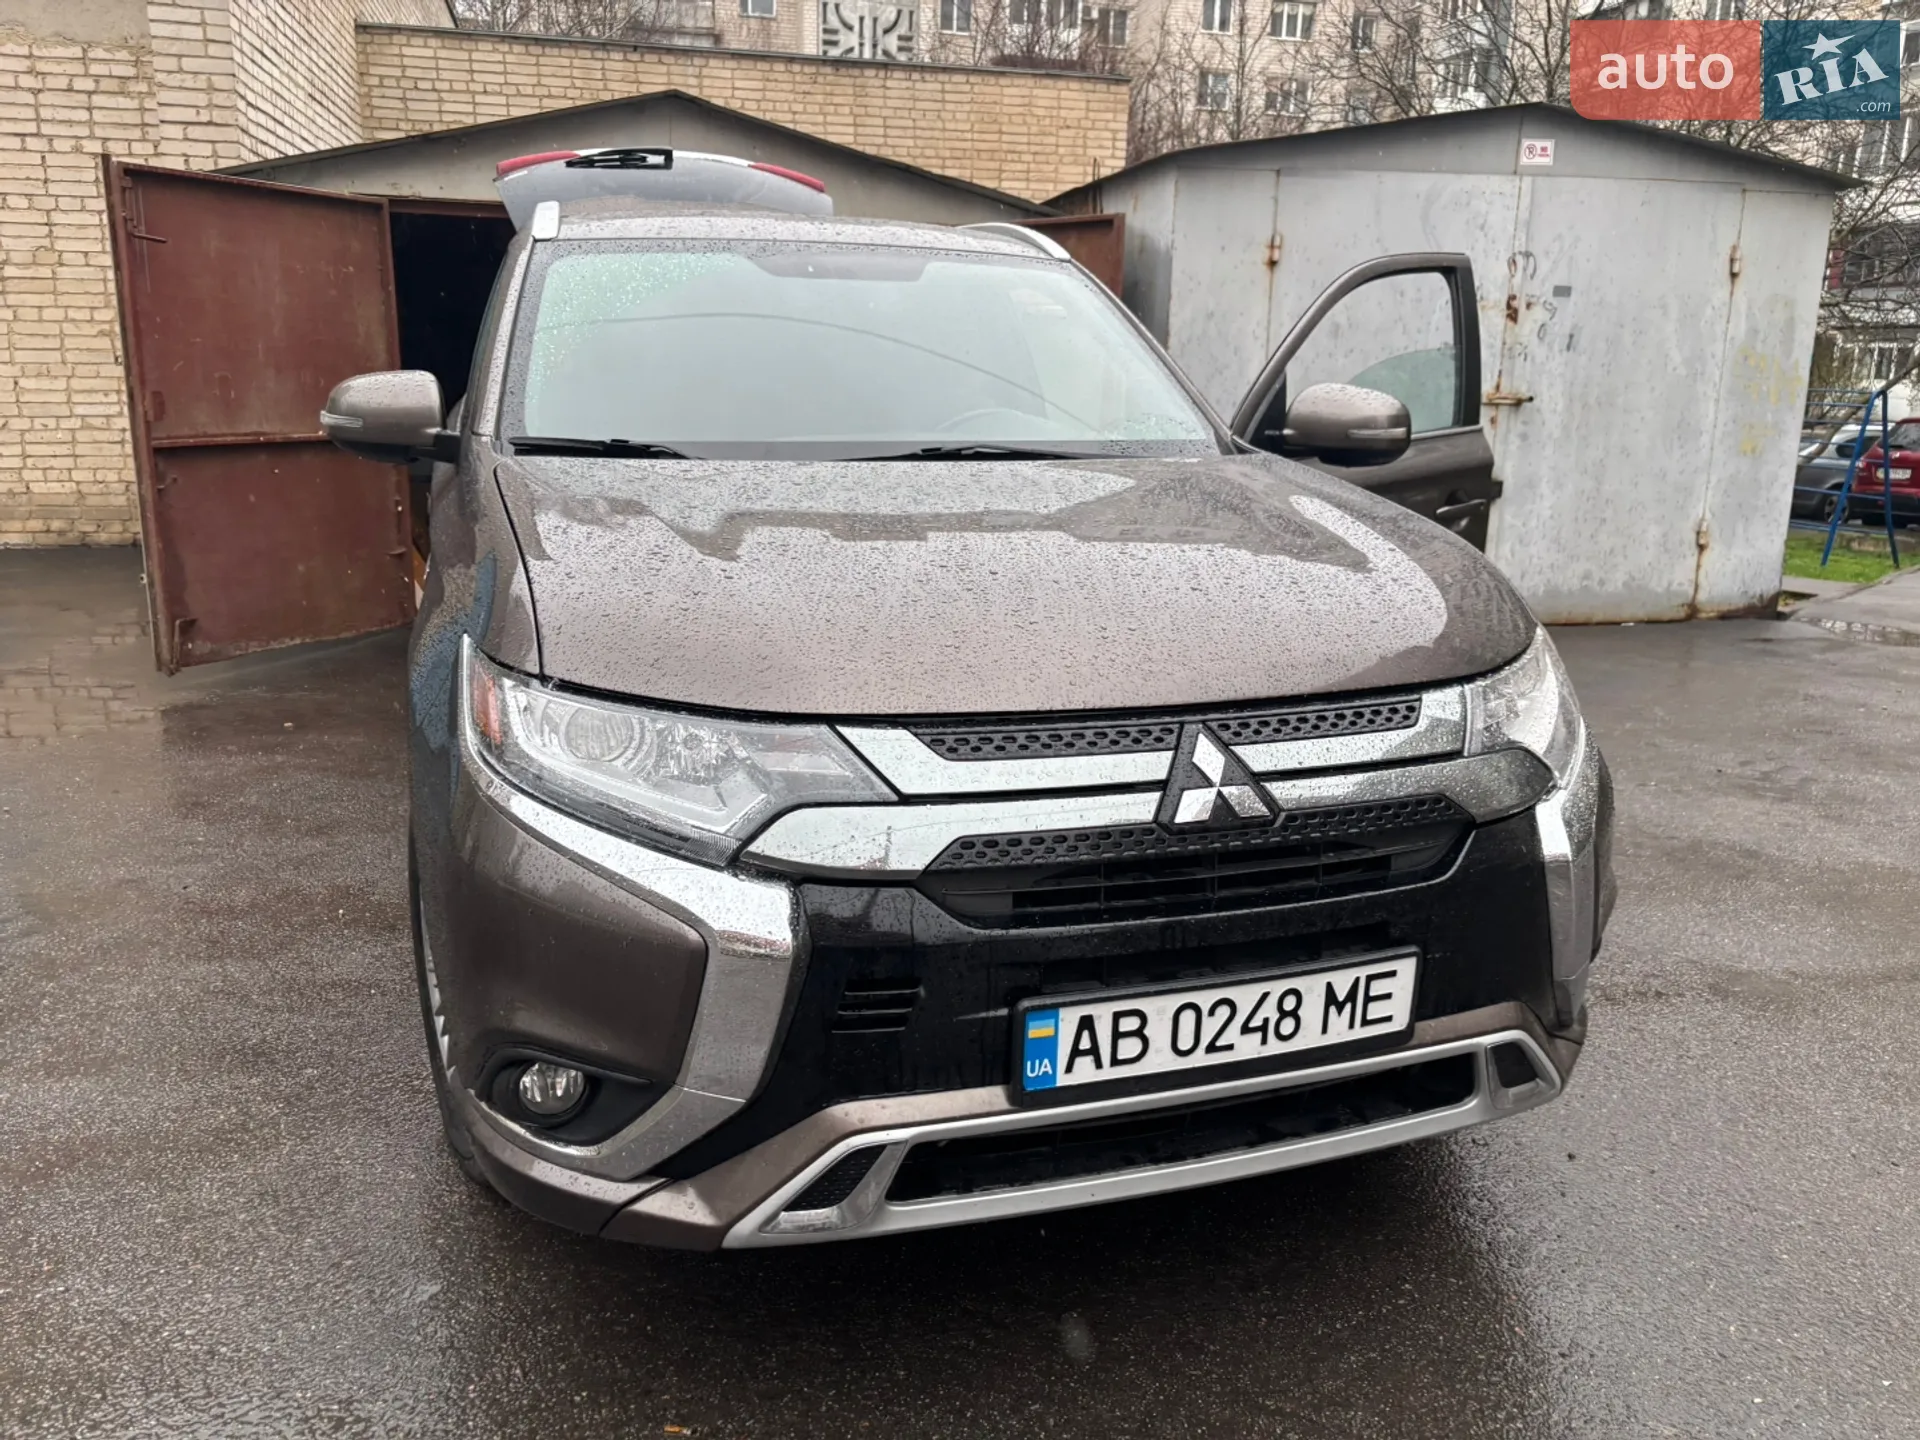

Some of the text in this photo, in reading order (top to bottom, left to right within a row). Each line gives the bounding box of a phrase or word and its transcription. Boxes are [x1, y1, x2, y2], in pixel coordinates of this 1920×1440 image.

[1064, 969, 1398, 1075] AB 0248 ME
[1026, 1060, 1053, 1079] UA
